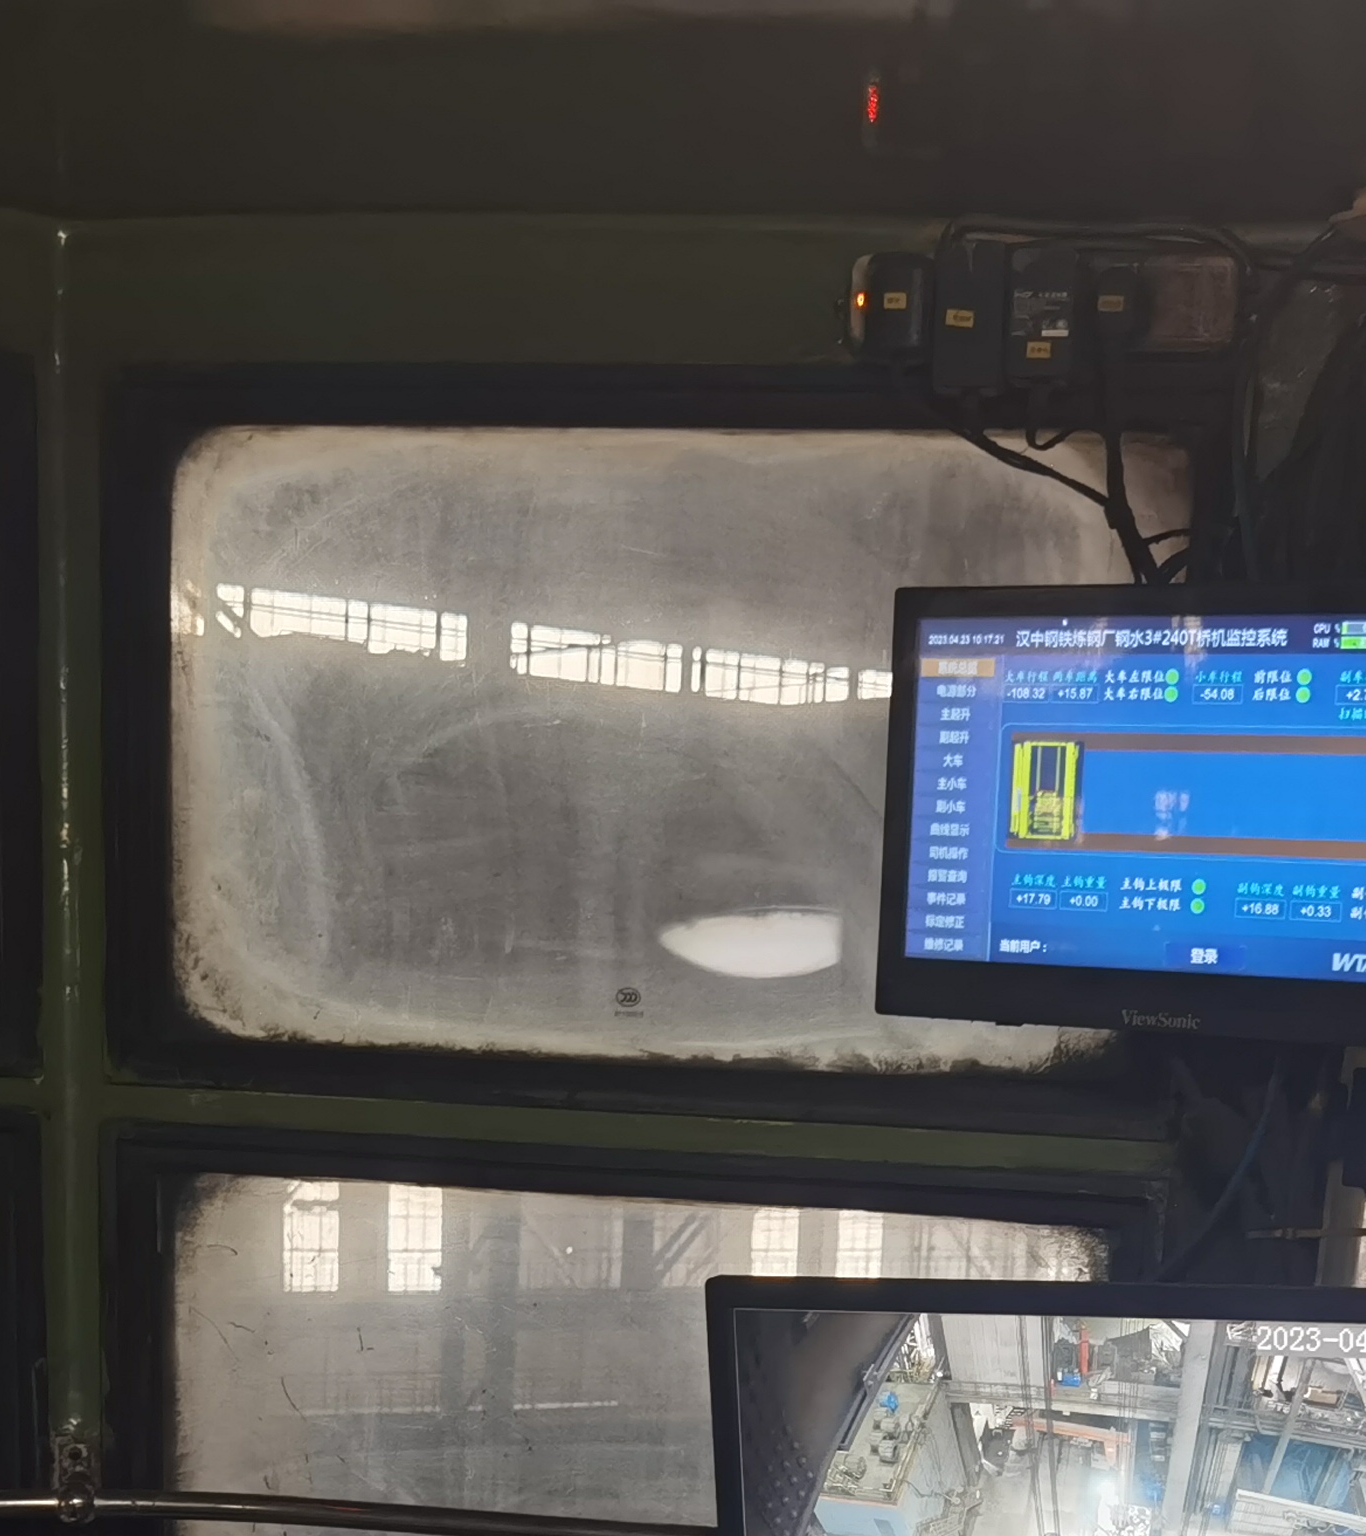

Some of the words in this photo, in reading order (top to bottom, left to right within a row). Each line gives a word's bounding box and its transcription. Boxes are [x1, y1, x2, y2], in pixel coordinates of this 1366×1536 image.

[1015, 628, 1288, 649] 汉中钢铁炼钢厂钢水3#240T桥机监控系统
[1007, 688, 1045, 699] -108.32
[1200, 689, 1235, 700] -54.08
[943, 753, 964, 767] 大车
[1300, 906, 1331, 918] +0.33
[1190, 948, 1219, 965] 登录
[1121, 1009, 1201, 1029] ViewSonic
